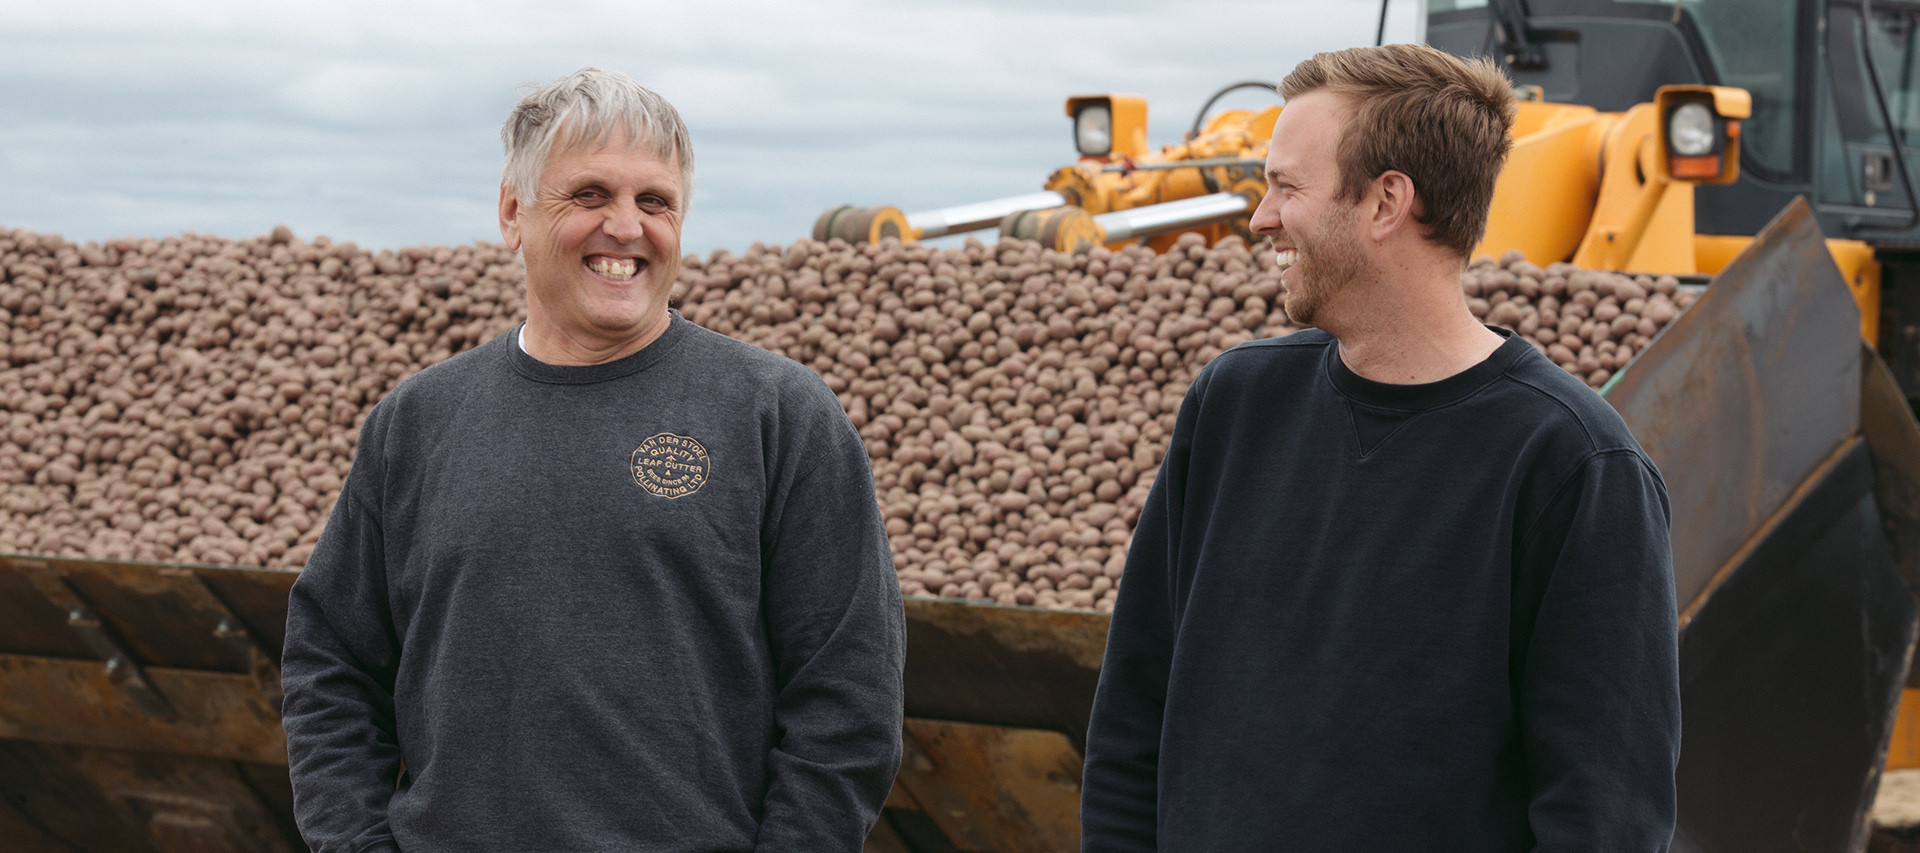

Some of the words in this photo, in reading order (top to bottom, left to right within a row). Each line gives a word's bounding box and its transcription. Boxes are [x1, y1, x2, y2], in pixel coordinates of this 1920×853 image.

[638, 439, 657, 454] VAN
[658, 436, 679, 445] DER
[681, 439, 707, 462] STOEL
[650, 446, 696, 462] QUALITY
[637, 457, 663, 467] LEAF
[664, 461, 703, 473] CUTTER
[634, 465, 688, 495] POLLINATING
[687, 473, 703, 489] LTD
[661, 478, 683, 486] SINCE
